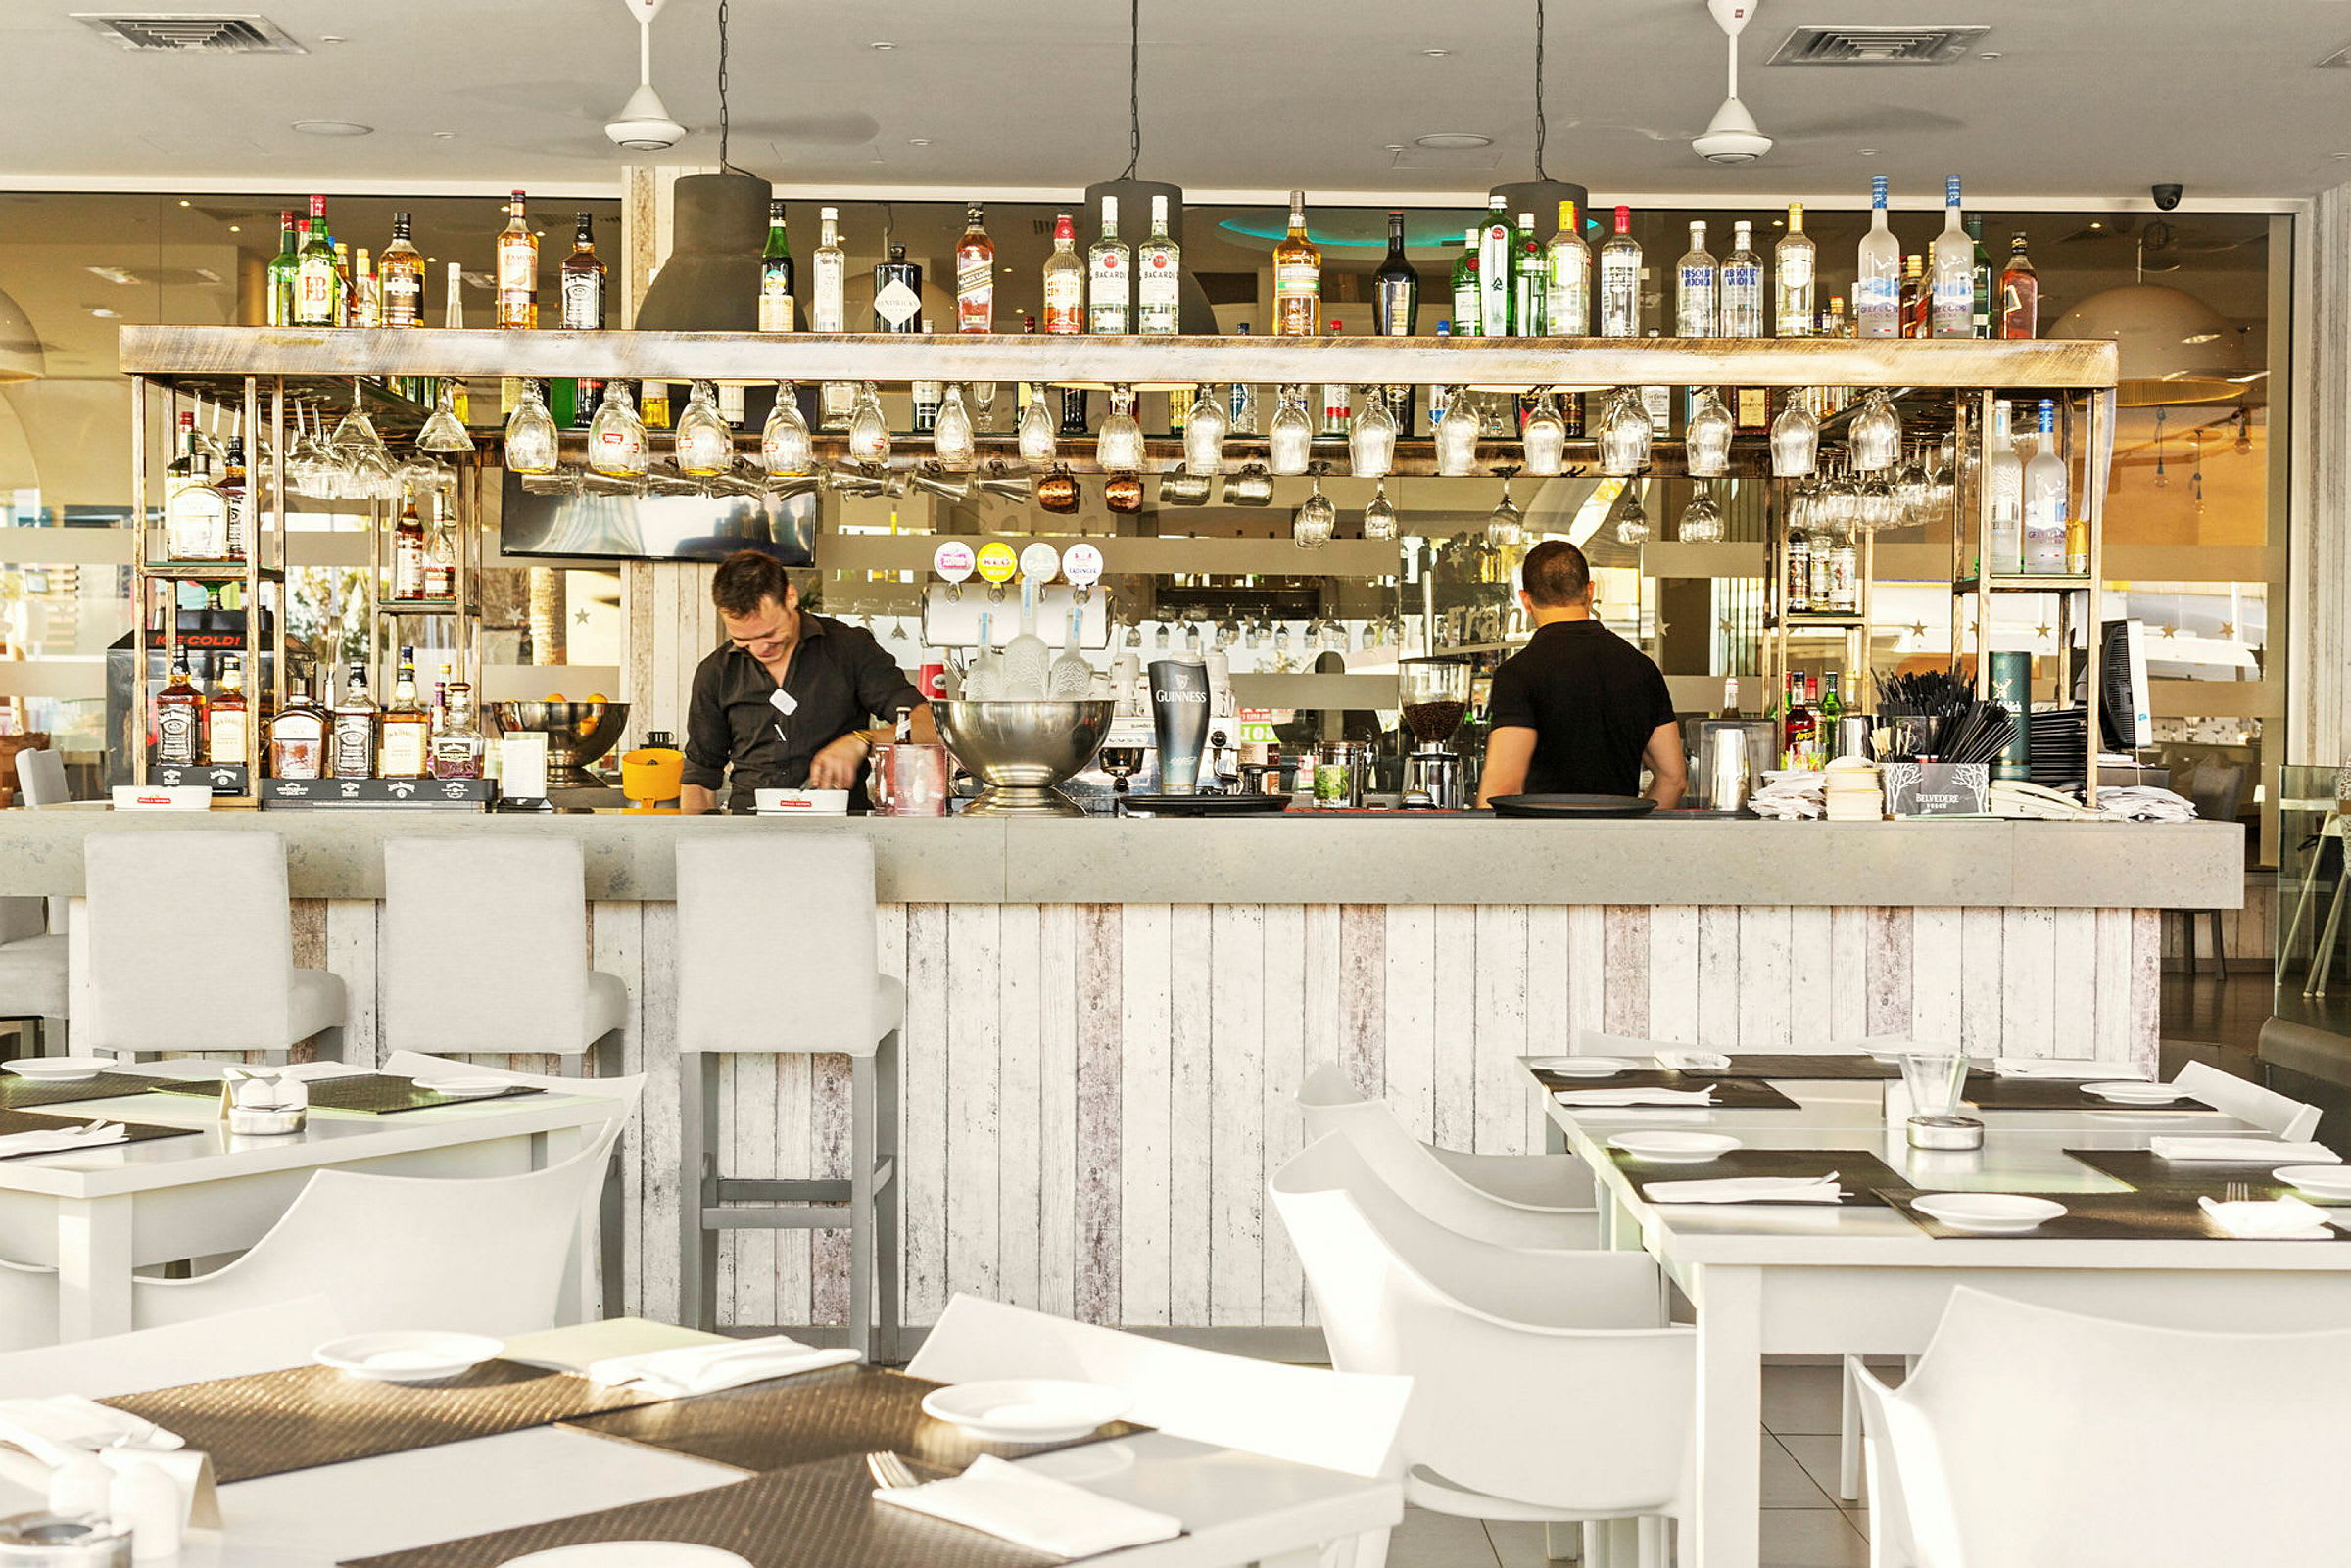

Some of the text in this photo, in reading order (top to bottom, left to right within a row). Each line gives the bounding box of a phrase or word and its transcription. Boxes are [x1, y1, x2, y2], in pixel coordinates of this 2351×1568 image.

[187, 635, 241, 646] COLD!
[1156, 689, 1207, 703] GUINNESS
[1915, 793, 1960, 803] BELVEDERE
